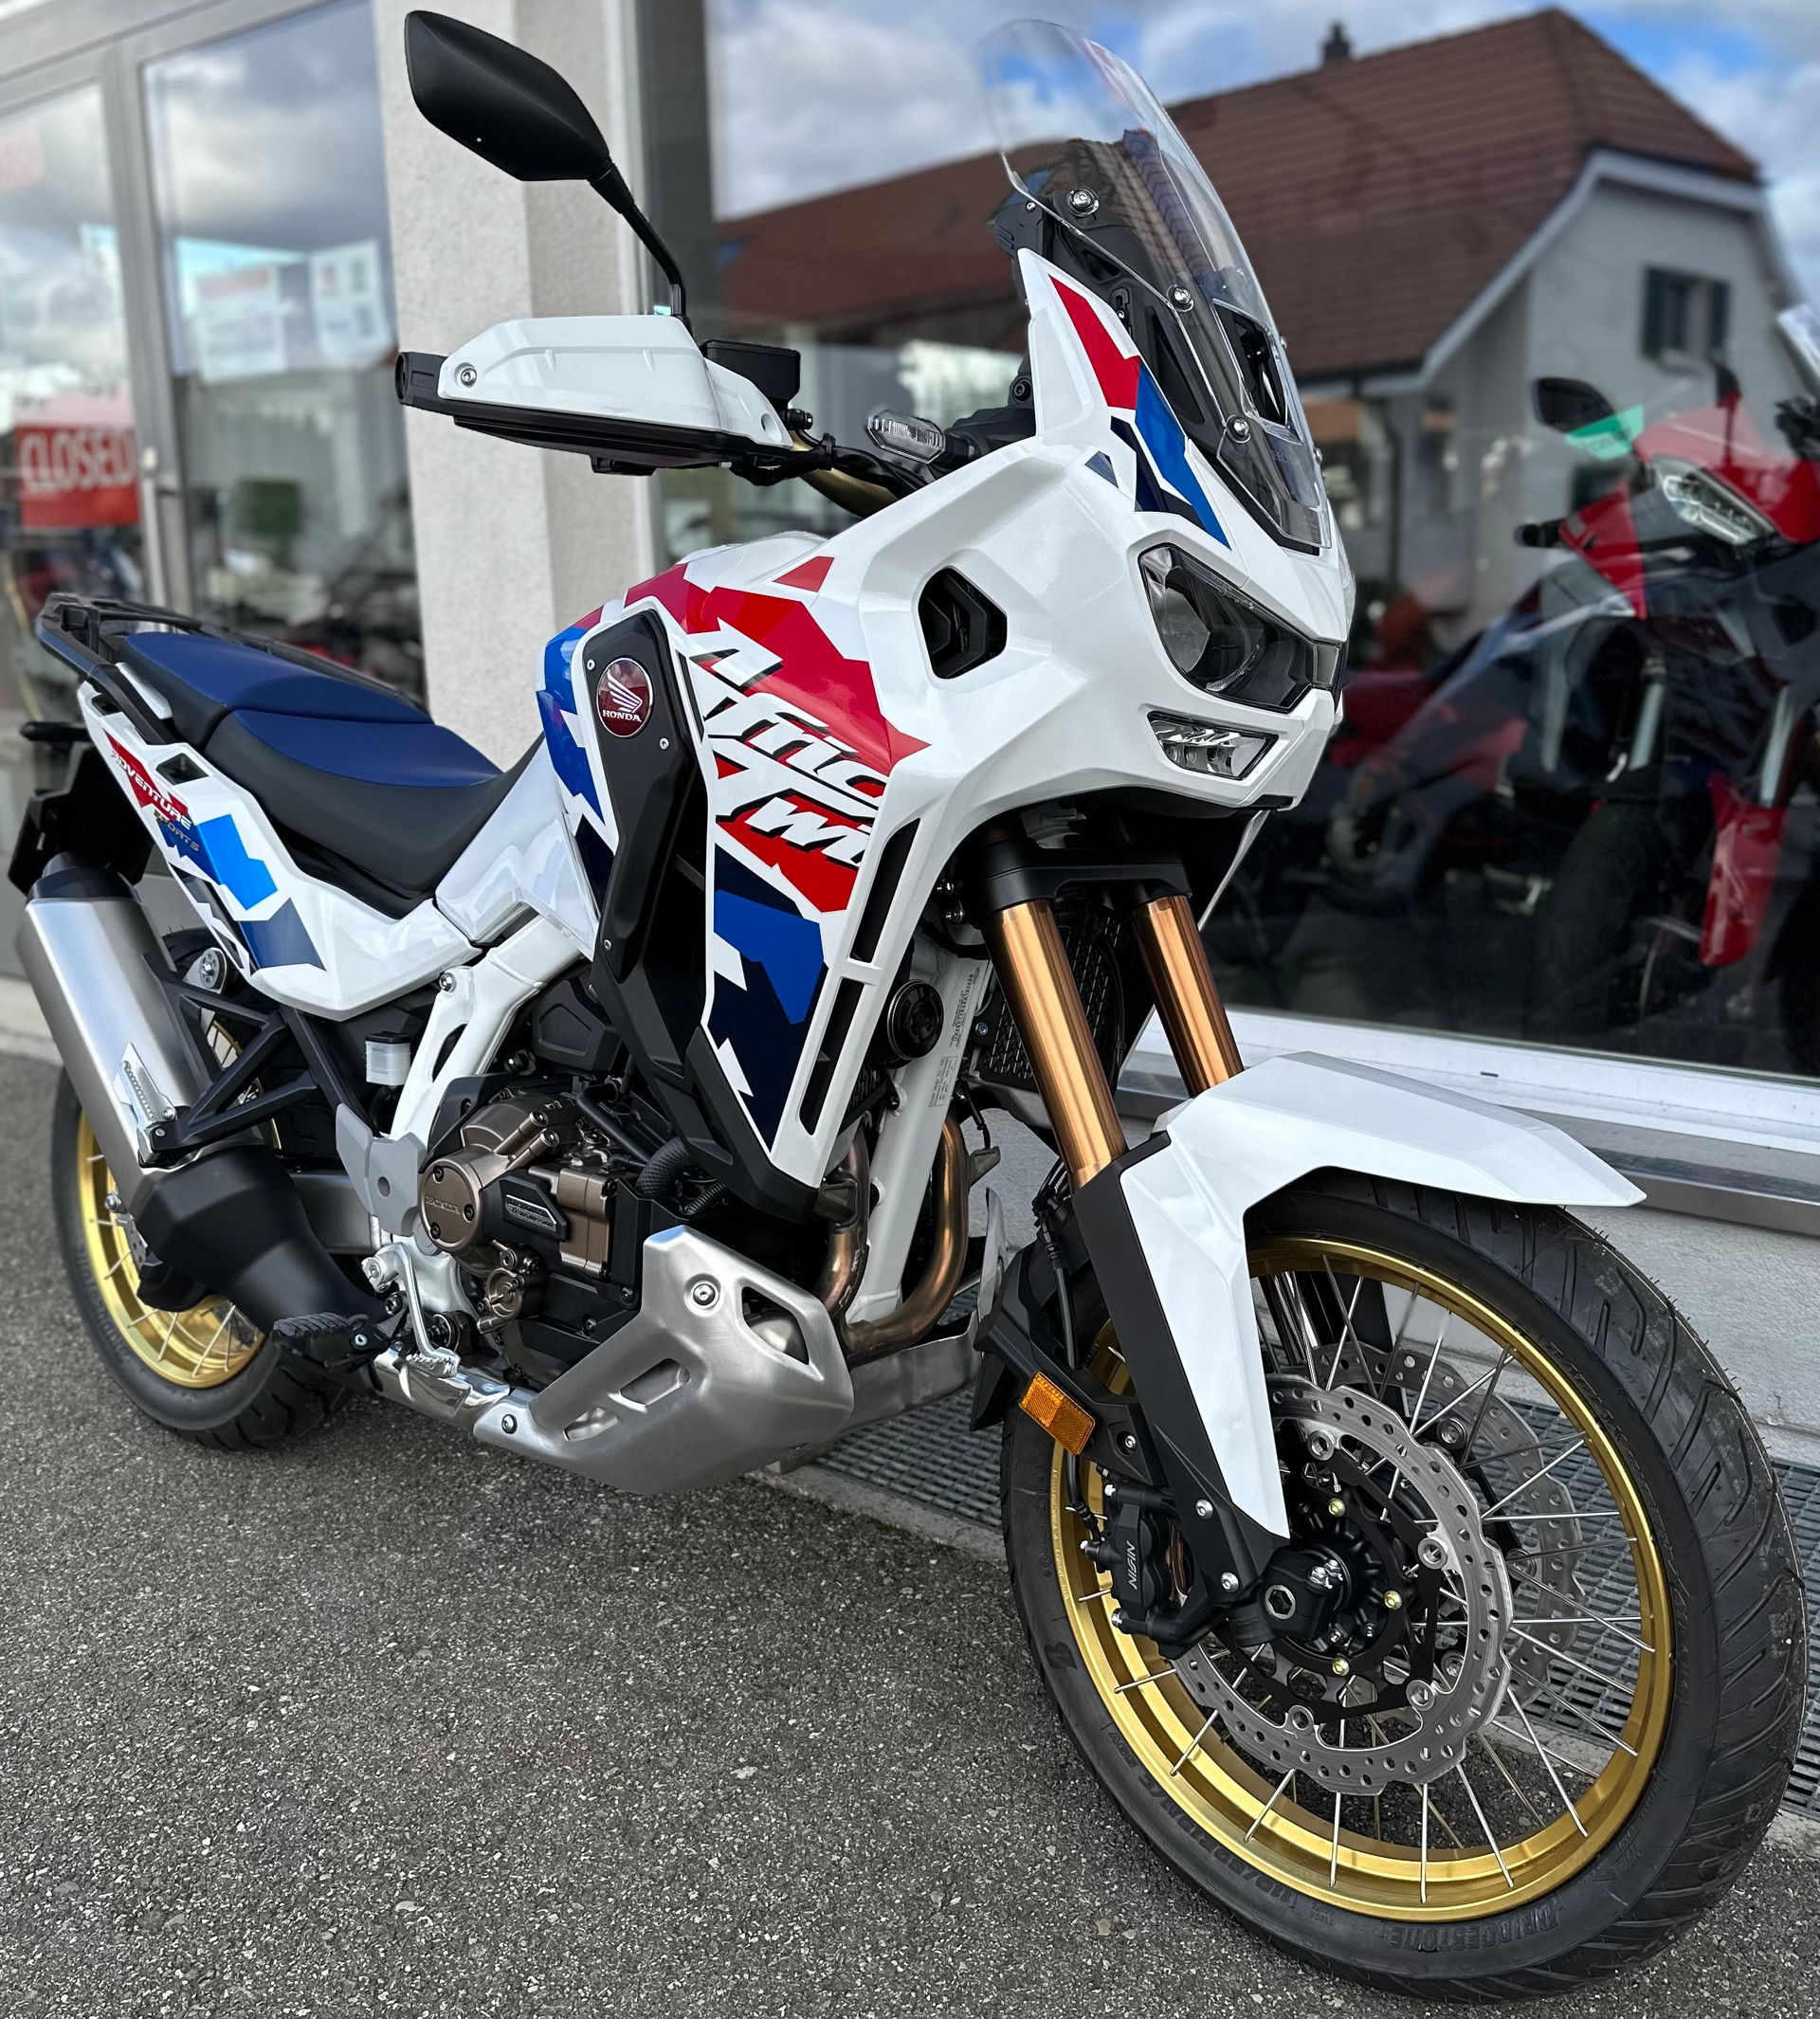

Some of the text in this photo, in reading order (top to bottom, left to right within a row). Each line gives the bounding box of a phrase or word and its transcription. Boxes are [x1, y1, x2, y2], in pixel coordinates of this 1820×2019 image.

[20, 427, 137, 495] CLOSED
[602, 709, 643, 723] HONDA
[111, 750, 192, 830] ADVENTURE
[1126, 1539, 1138, 1591] NISSIN
[1388, 1898, 1560, 1953] BRIDGESTONE
